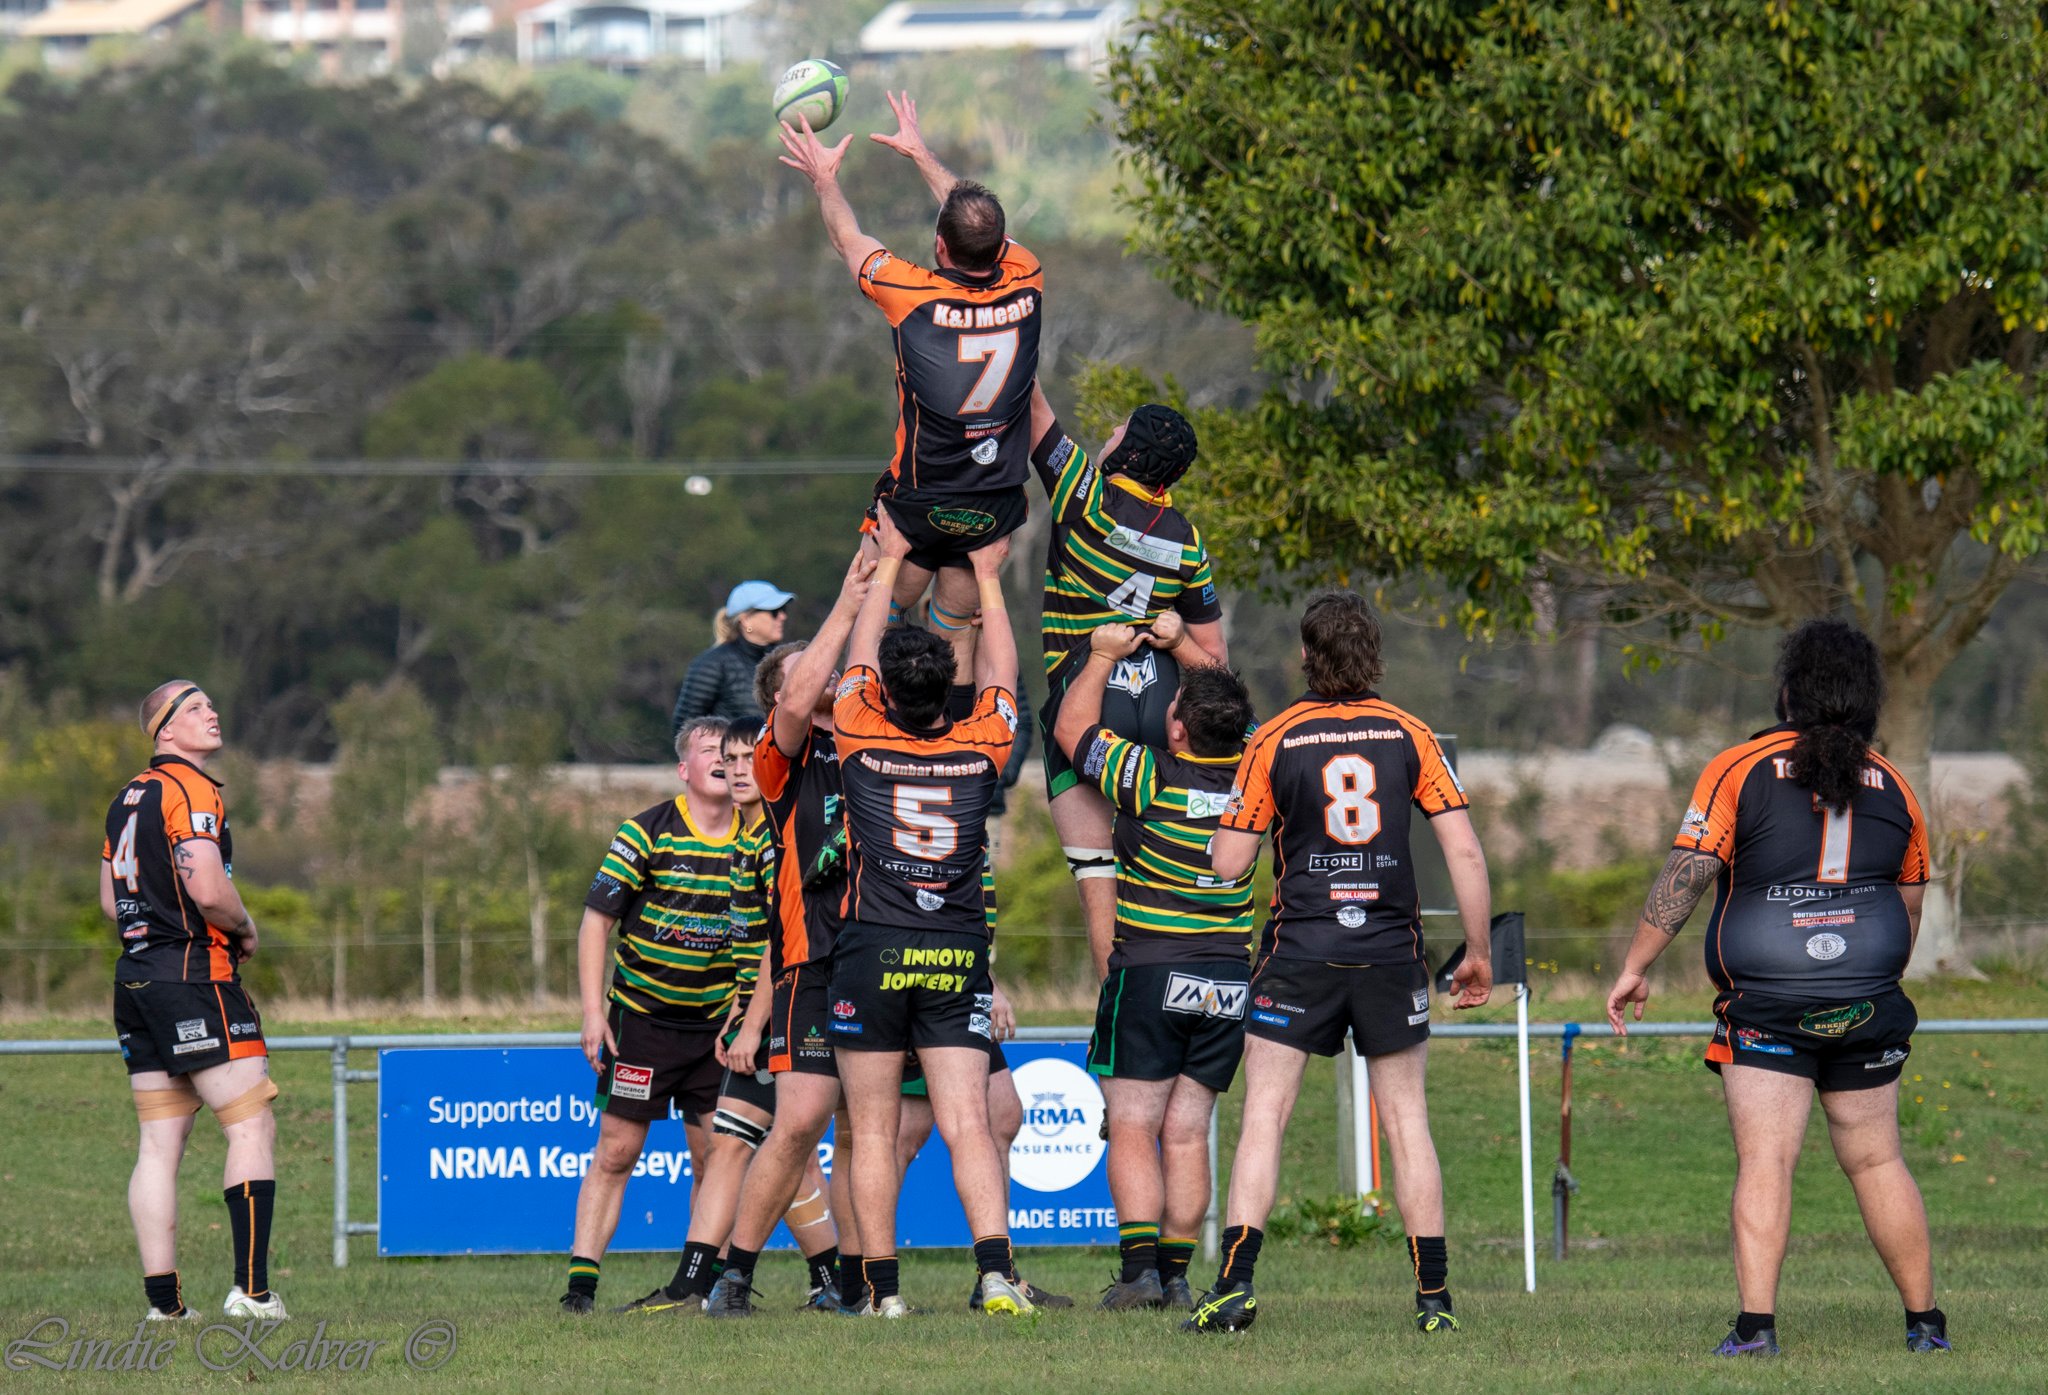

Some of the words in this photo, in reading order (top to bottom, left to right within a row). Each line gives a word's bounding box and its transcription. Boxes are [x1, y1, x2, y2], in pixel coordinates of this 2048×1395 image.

[933, 303, 973, 329] K&J
[975, 295, 1035, 328] Meats
[957, 327, 1020, 415] 7
[1106, 571, 1156, 619] 4
[1319, 732, 1347, 743] Valley
[1347, 730, 1367, 741] Vets
[881, 760, 931, 776] Dunbar
[932, 759, 988, 776] Massage
[1322, 753, 1382, 845] 8
[892, 784, 958, 861] 5
[1813, 792, 1852, 884] 1
[112, 811, 139, 893] 4
[1315, 857, 1358, 867] STONE
[1773, 888, 1826, 897] STONE
[1850, 886, 1877, 895] ESTATE
[1792, 911, 1827, 919] SOUTHSIDE
[1795, 918, 1822, 926] LOCAL
[1822, 916, 1853, 924] LIQUOR
[902, 948, 975, 969] INNOV8
[879, 972, 967, 993] JOINERY
[616, 1068, 648, 1083] Elders
[615, 1083, 645, 1094] Insurance
[428, 1094, 561, 1129] Supported
[570, 1094, 598, 1128] by
[1011, 1144, 1094, 1155] NSURANCE
[430, 1146, 532, 1180] NRMA
[539, 1146, 692, 1185] Kesey:
[1059, 1208, 1119, 1228] BETTE
